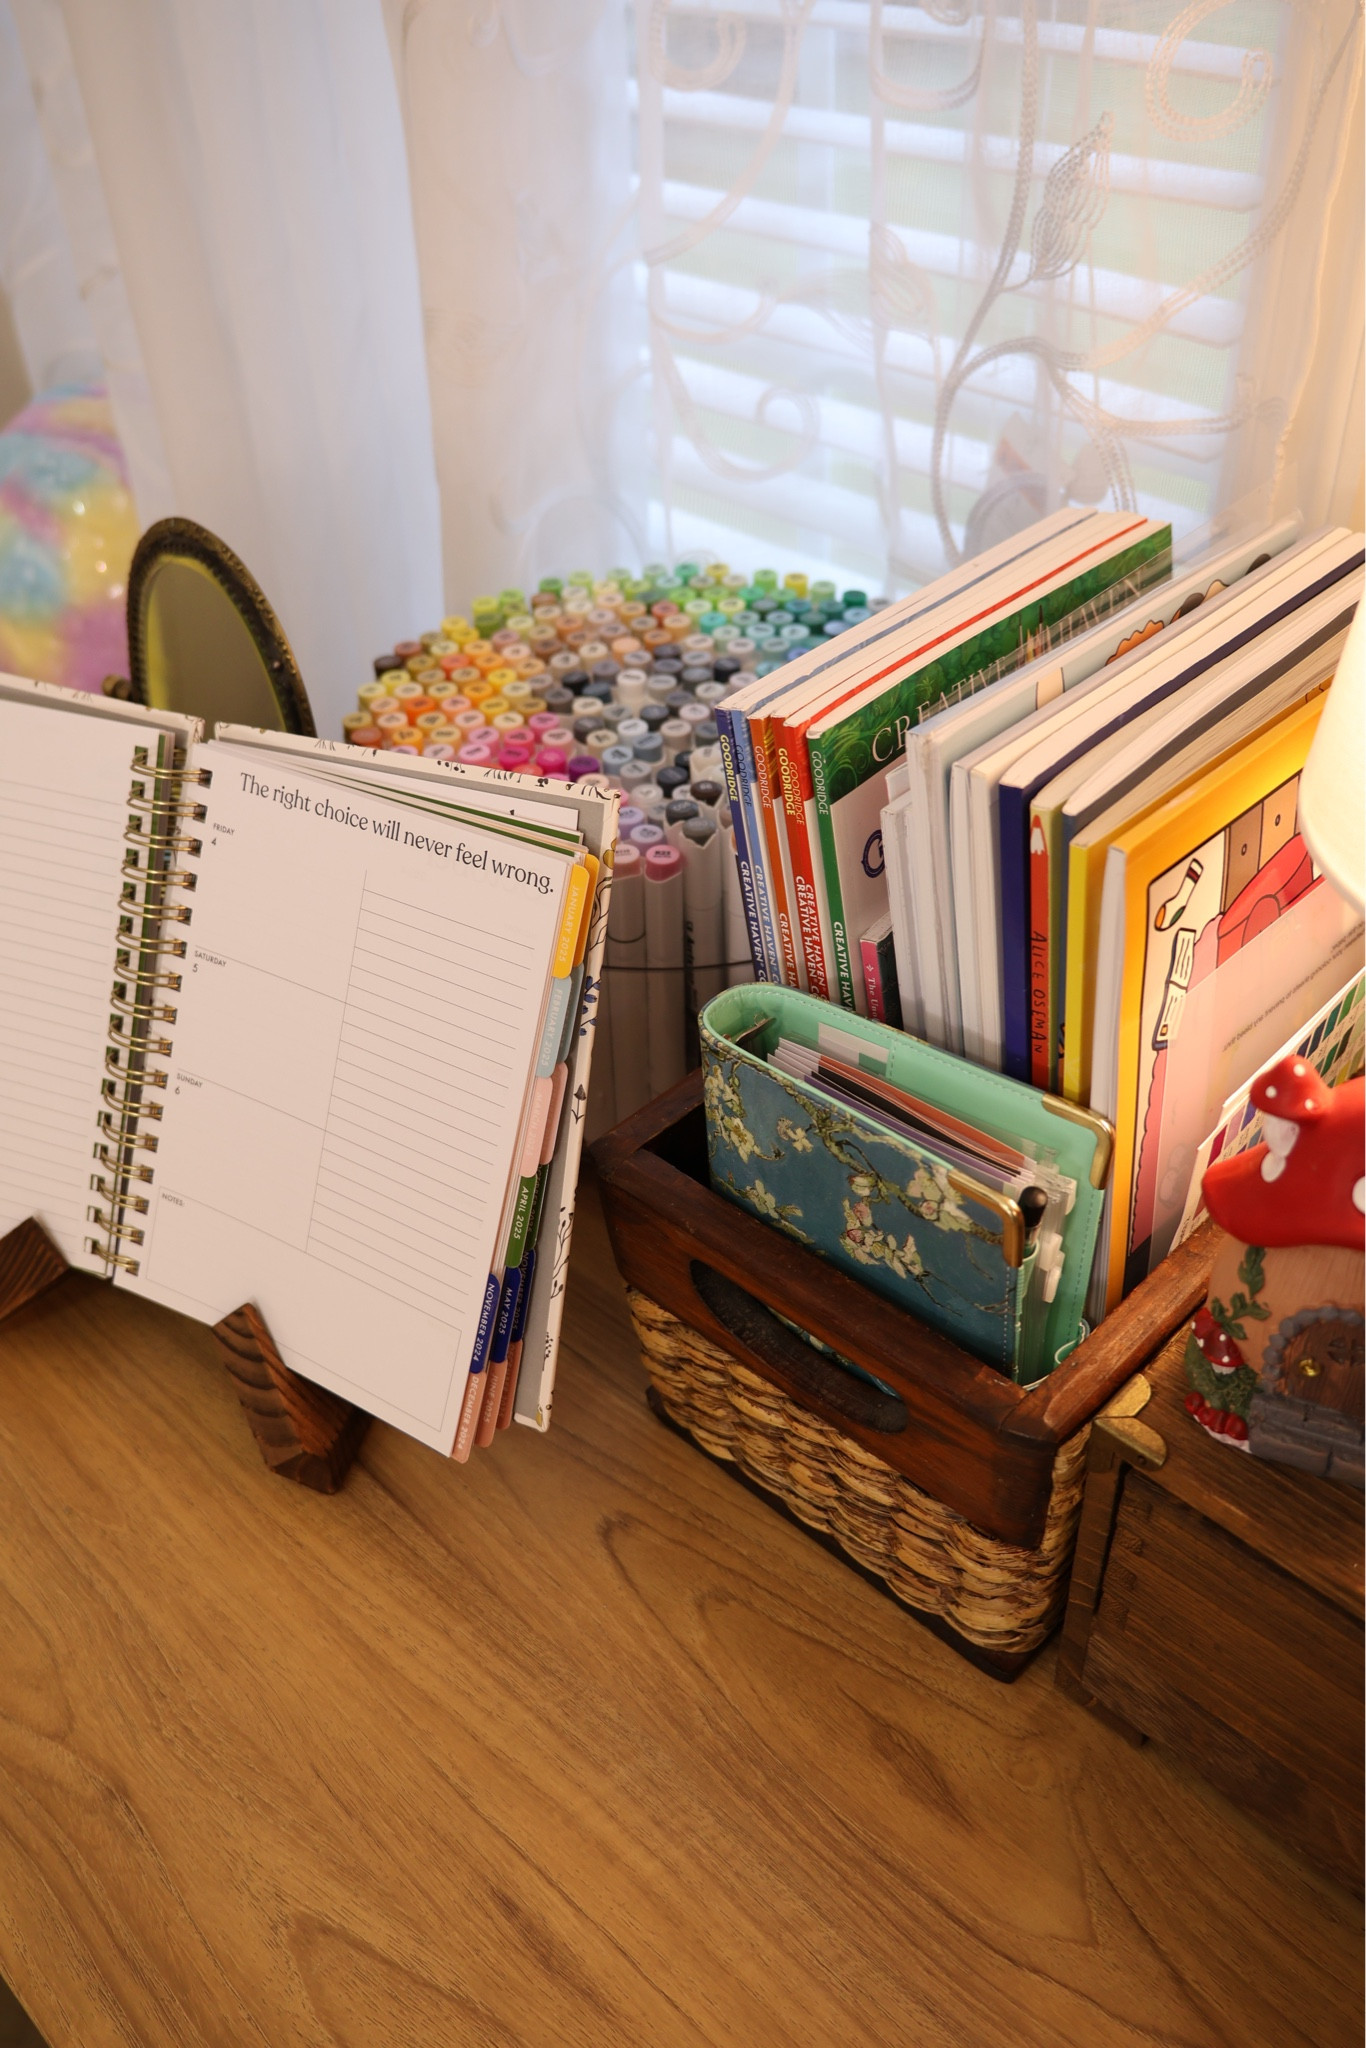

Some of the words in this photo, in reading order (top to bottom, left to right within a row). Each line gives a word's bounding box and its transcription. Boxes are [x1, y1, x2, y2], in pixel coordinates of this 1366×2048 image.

[720, 734, 738, 802] GOODRIDGE
[736, 744, 752, 808] GOODRIDGE
[755, 745, 772, 809] GOODRIDGE
[778, 747, 796, 816] GOODRIDGE
[811, 750, 829, 815] GOODRIDGE
[789, 761, 805, 825] GOODRIDGE
[211, 837, 217, 847] 4
[212, 822, 235, 837] FRIDAY
[240, 772, 270, 798] The
[272, 785, 312, 812] right
[314, 799, 369, 831] choice
[372, 819, 401, 842] will
[403, 830, 453, 858] never
[455, 842, 488, 871] feel
[491, 859, 554, 894] wrong.
[564, 885, 580, 935] JANUARY
[740, 861, 757, 918] CREATIVE
[755, 865, 770, 922] CREATIVE
[796, 876, 812, 932] CREATIVE
[805, 884, 820, 941] CREATIVE
[194, 950, 227, 967] SATURDAY
[558, 935, 570, 963] 2025
[779, 913, 795, 969] CREATIVE
[1030, 931, 1048, 978] ALICE
[192, 963, 199, 973] 5
[834, 921, 849, 978] CREATIVE
[842, 980, 853, 1010] HAV
[868, 977, 877, 995] The
[546, 989, 564, 1038] FEBRUARY
[1030, 988, 1047, 1053] OSEMAN
[541, 1041, 553, 1067] 2025
[174, 1086, 181, 1095] 6
[176, 1072, 203, 1088] SUNDAY
[518, 1186, 530, 1212] APRIL
[513, 1214, 525, 1240] 2025
[478, 1283, 496, 1336] NOVEMBER
[499, 1310, 509, 1335] 2025
[503, 1287, 513, 1310] MAY
[472, 1337, 484, 1362] 2024
[466, 1375, 480, 1425] DECEMBER
[487, 1375, 499, 1399] JUNE
[483, 1401, 495, 1424] 2025
[458, 1426, 469, 1450] 2024
